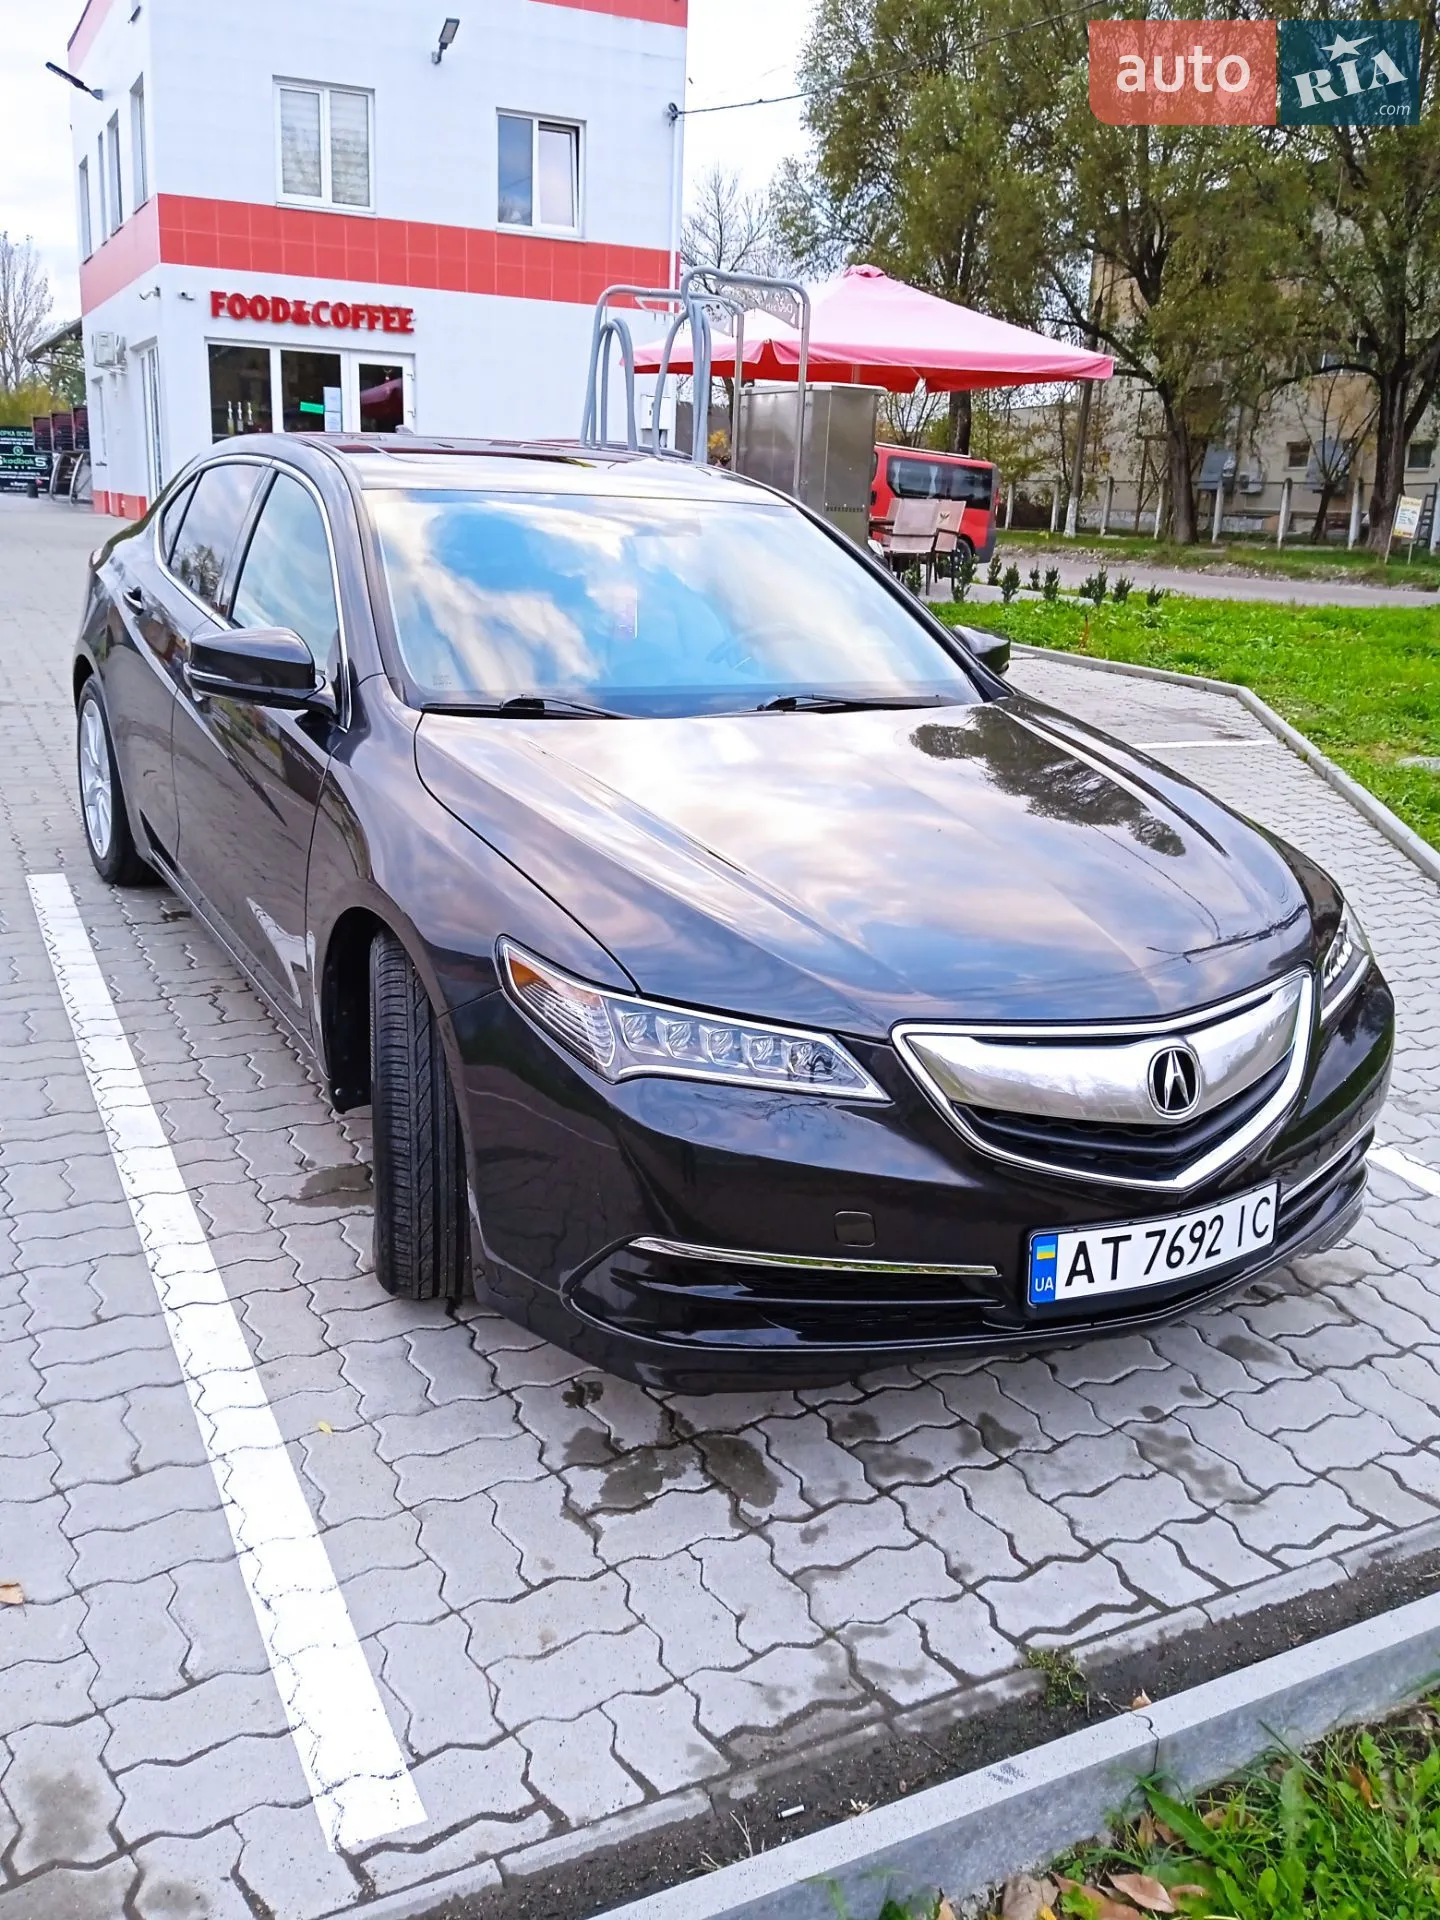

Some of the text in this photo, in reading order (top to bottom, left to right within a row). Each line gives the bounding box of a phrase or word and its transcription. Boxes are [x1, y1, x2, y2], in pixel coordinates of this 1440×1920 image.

[210, 290, 415, 333] FOOD&COFFEE
[1065, 1196, 1271, 1287] AT 7692 IC
[1035, 1276, 1054, 1292] UA
